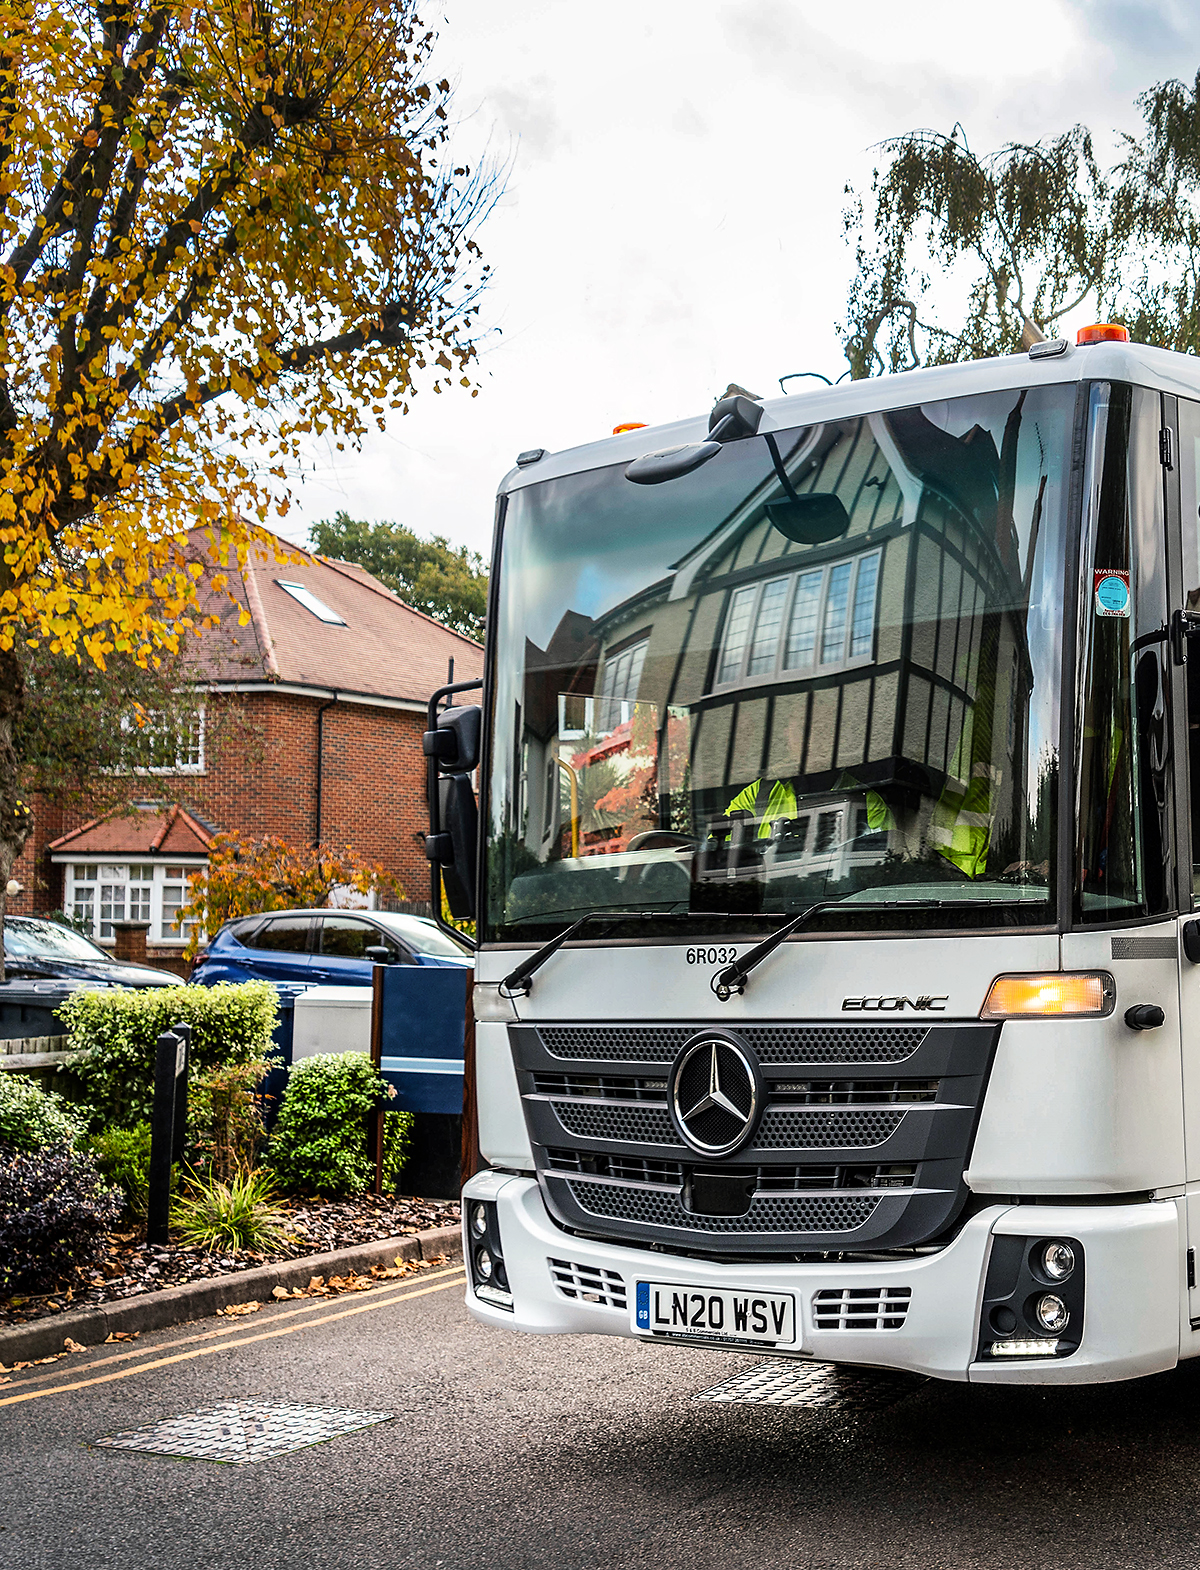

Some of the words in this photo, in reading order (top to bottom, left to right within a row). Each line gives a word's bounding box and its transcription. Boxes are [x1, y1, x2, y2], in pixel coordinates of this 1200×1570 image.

[686, 947, 737, 964] 6R032
[842, 995, 949, 1011] ECONIC
[638, 1310, 649, 1320] GB
[655, 1291, 724, 1329] LN20
[733, 1297, 786, 1335] WSV
